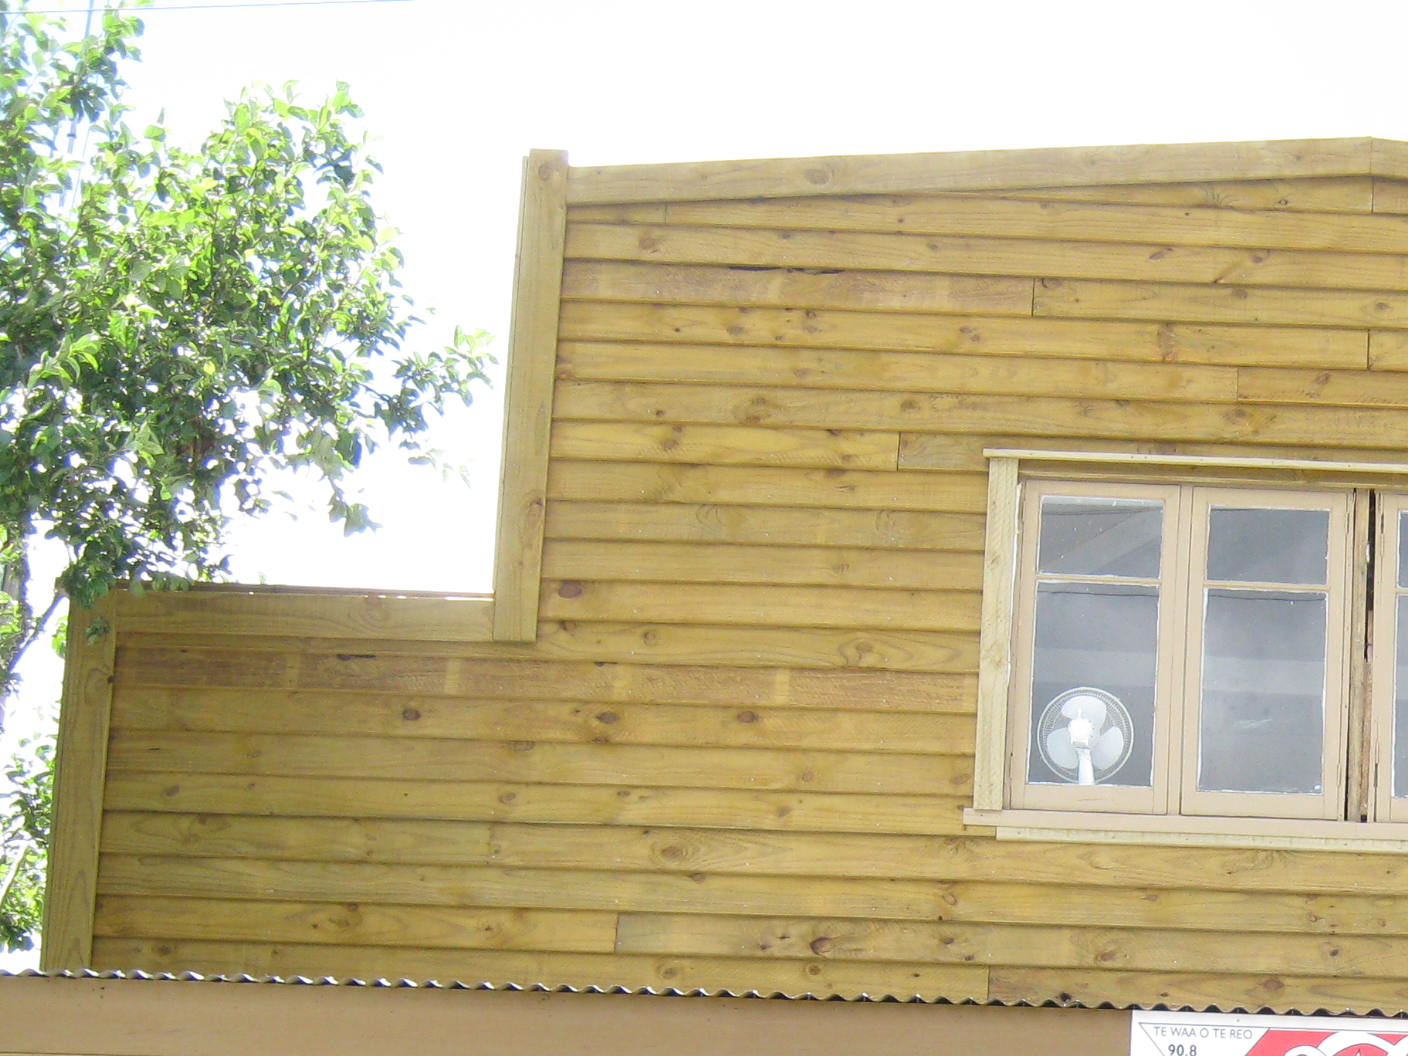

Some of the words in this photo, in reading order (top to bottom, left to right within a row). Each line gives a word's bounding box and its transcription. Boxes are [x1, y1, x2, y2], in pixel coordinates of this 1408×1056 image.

[1153, 1026, 1167, 1037] TE
[1170, 1026, 1196, 1038] WAA
[1199, 1027, 1209, 1039] O
[1212, 1028, 1226, 1039] TE
[1229, 1029, 1253, 1040] REO
